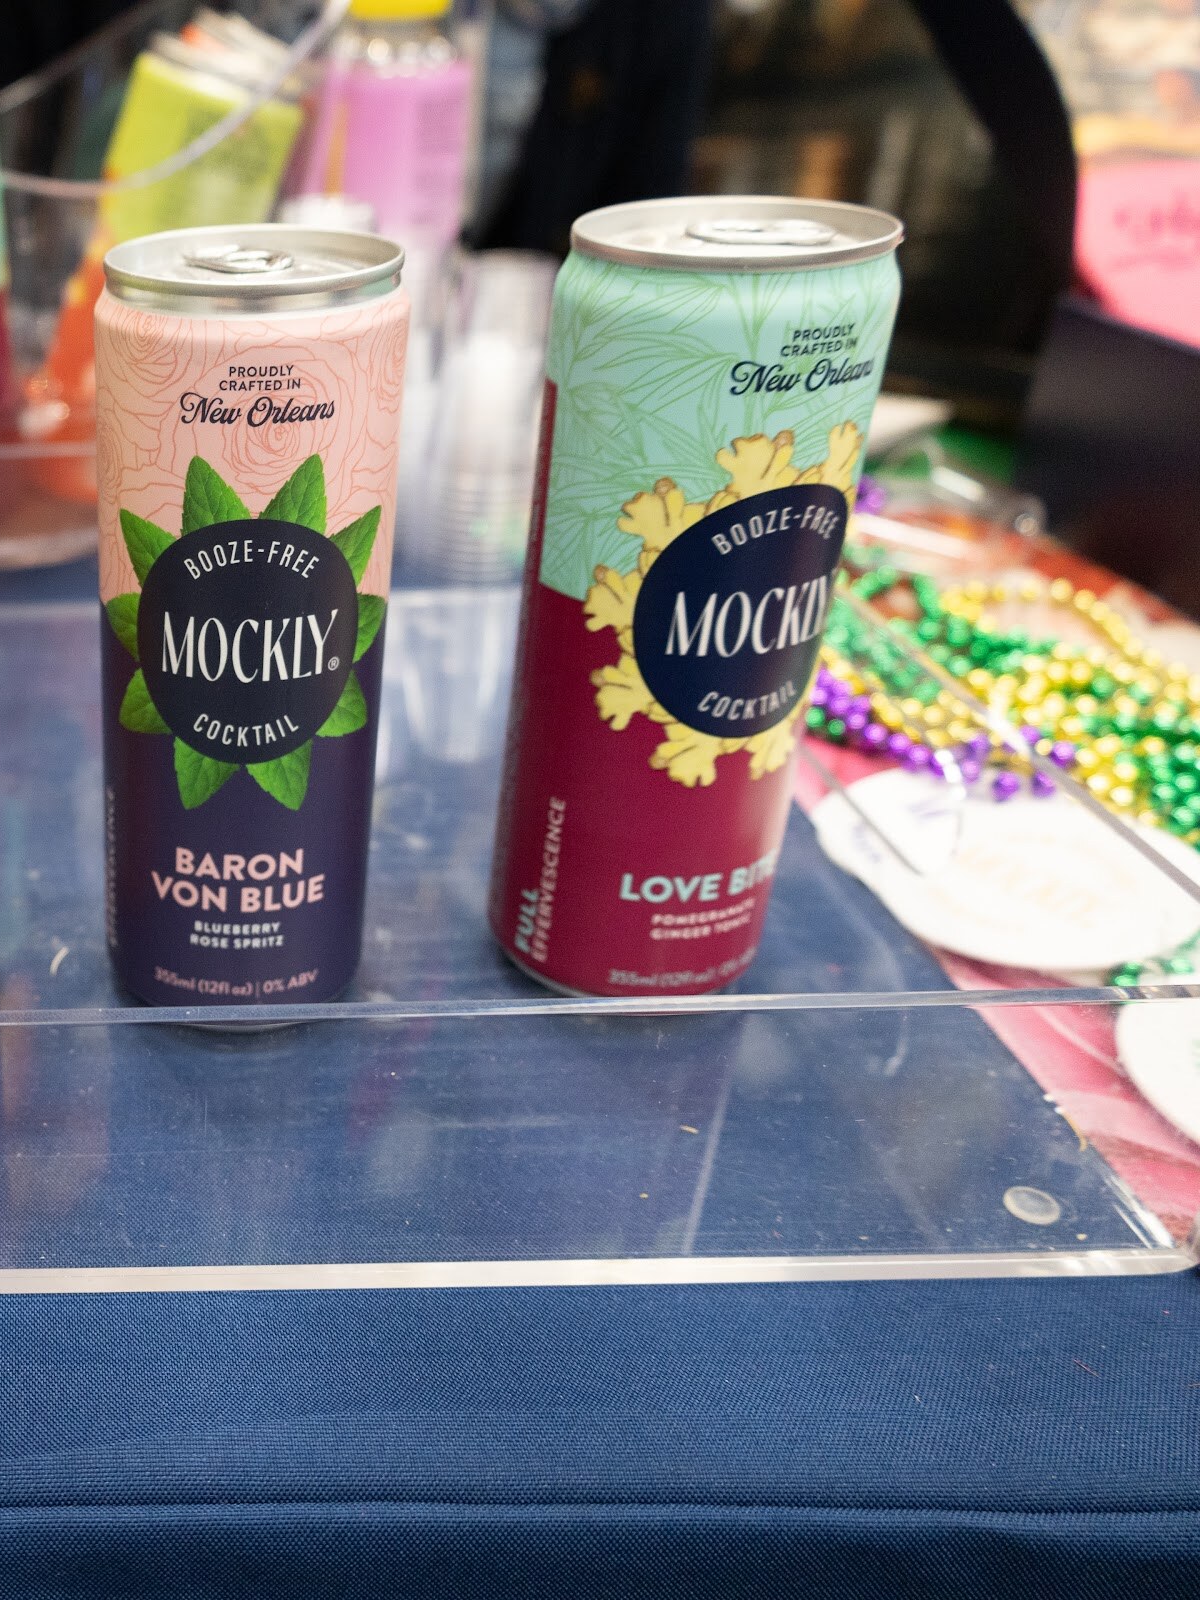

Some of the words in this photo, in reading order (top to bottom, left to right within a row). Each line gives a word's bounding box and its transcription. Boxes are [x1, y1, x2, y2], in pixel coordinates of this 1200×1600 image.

[792, 323, 856, 341] PROUDLY
[781, 342, 841, 357] CRAFTED
[219, 379, 282, 391] CRAFTED
[287, 378, 301, 389] IN
[229, 365, 293, 377] PROUDLY
[730, 361, 800, 395] New
[180, 392, 241, 424] New
[247, 394, 335, 427] Orleans
[183, 539, 320, 580] BOOZE-FREE
[697, 681, 798, 721] COCKTAIL
[193, 713, 300, 747] COCKTAIL
[175, 846, 305, 882] BARON
[151, 870, 228, 913] VON
[240, 873, 326, 914] BLUE
[619, 872, 724, 905] LOVE
[189, 933, 229, 949] ROSE
[233, 933, 285, 950] SPRITZ
[194, 920, 282, 936] BLUEBERRY
